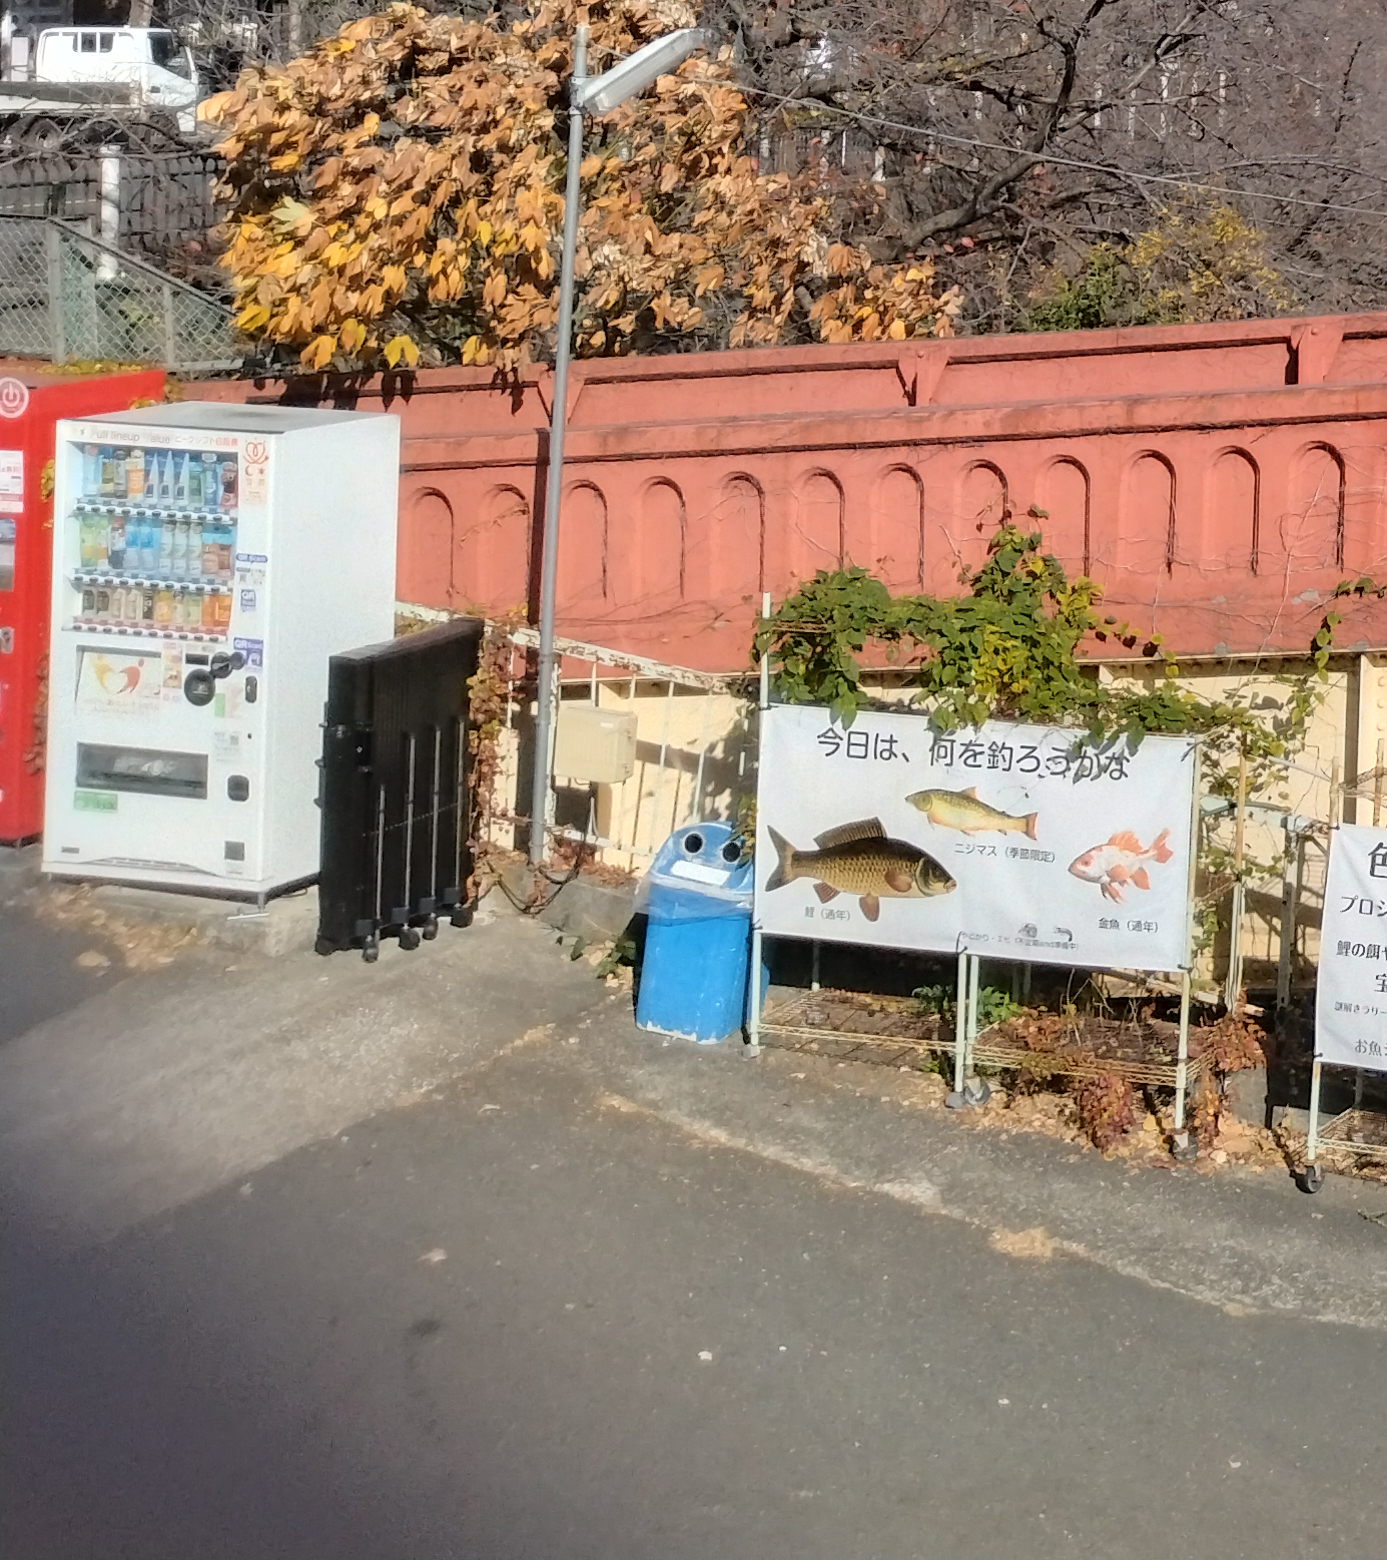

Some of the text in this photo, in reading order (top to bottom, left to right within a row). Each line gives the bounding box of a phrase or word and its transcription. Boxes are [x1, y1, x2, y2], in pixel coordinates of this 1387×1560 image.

[816, 727, 1131, 782] 今日は、何を釣ろうかな
